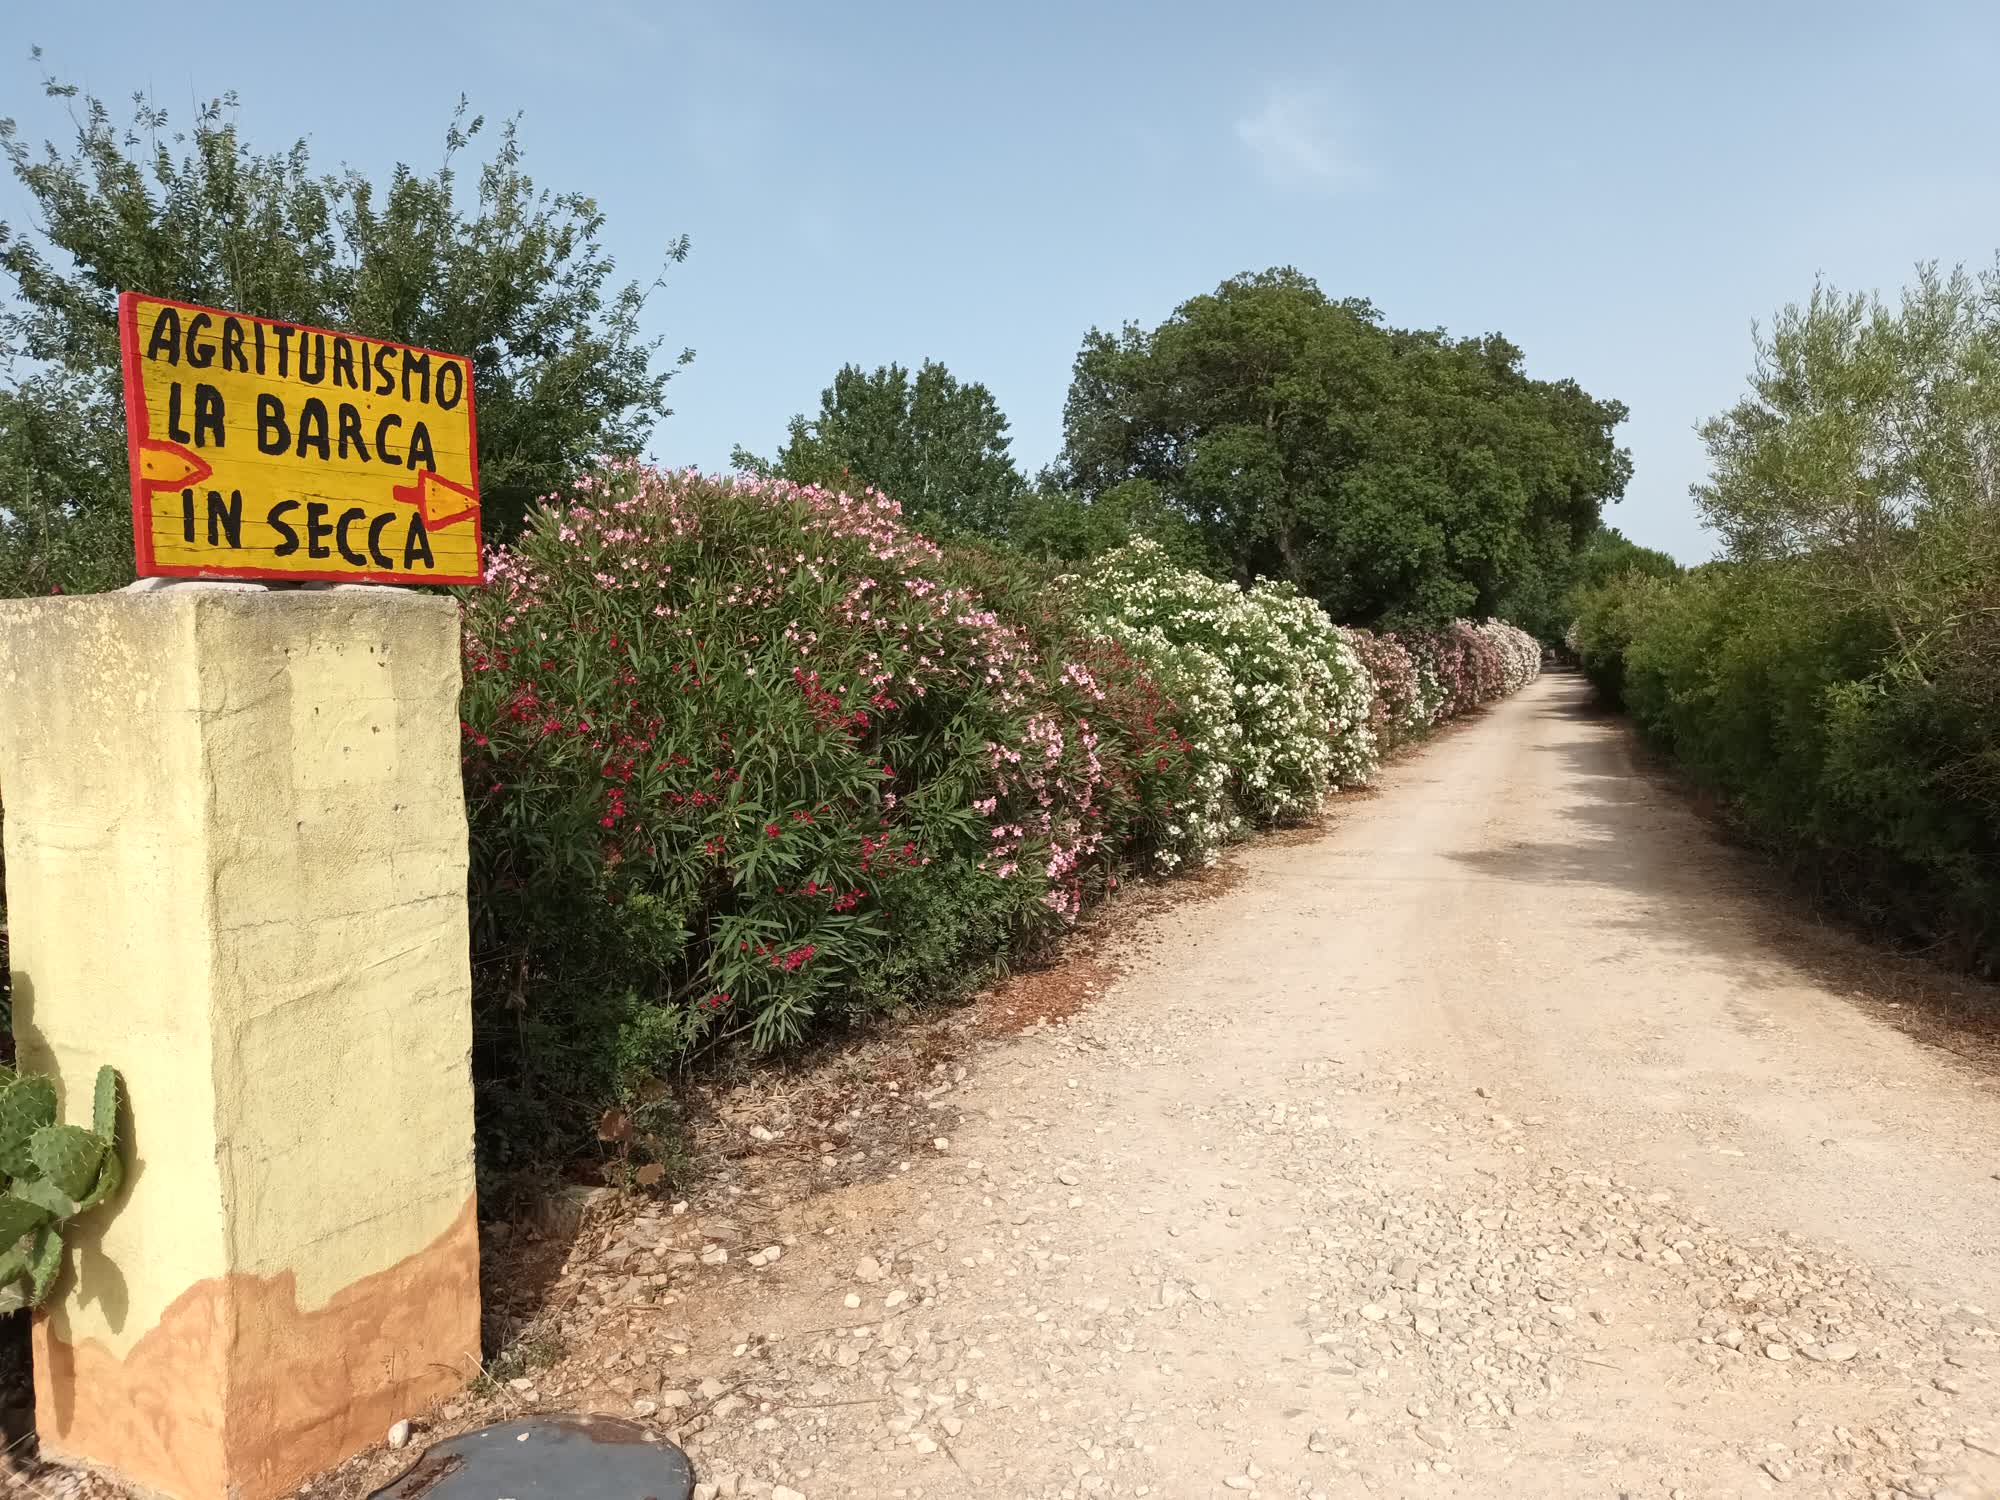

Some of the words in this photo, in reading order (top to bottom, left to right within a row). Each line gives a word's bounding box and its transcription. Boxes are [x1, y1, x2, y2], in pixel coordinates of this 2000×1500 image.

[147, 307, 463, 410] AGRITURISMO
[168, 382, 225, 448] LA
[257, 393, 436, 473] BARCA
[182, 488, 242, 549] IN
[267, 500, 434, 570] SECCA
